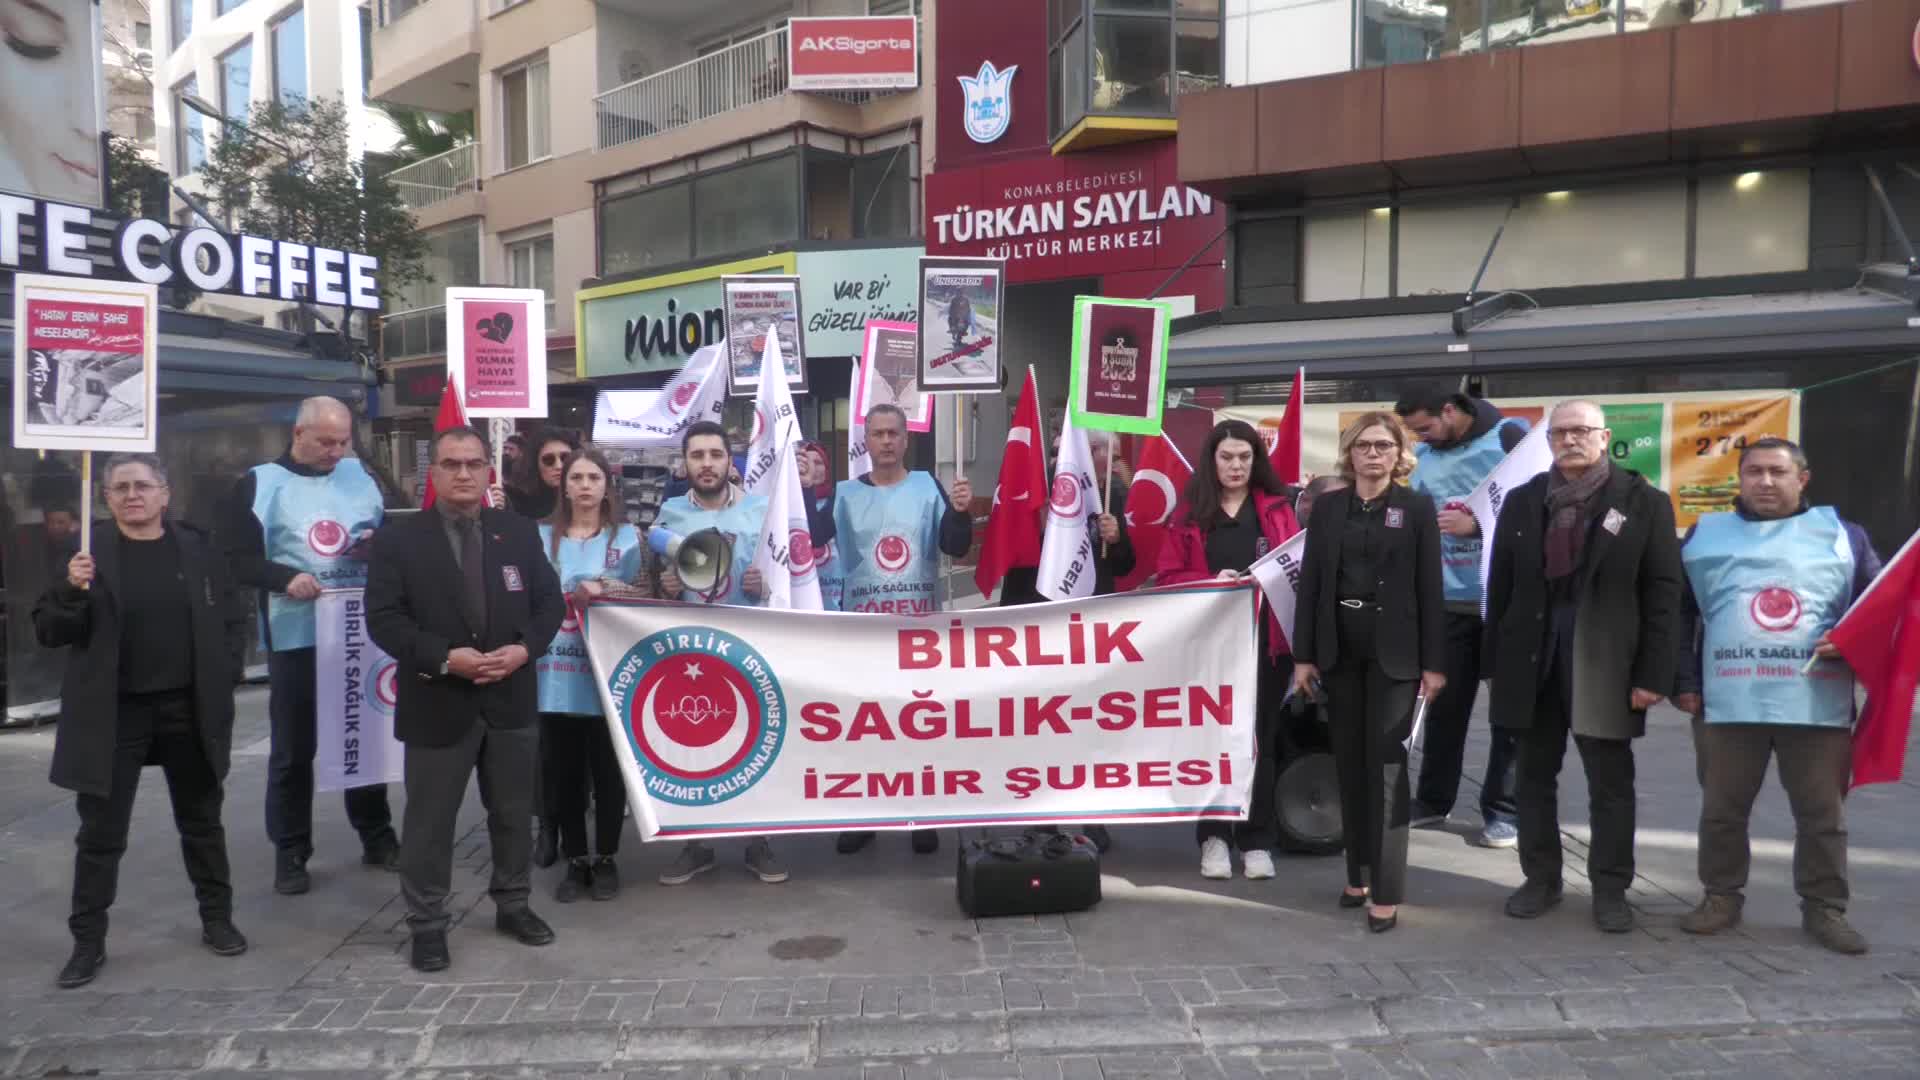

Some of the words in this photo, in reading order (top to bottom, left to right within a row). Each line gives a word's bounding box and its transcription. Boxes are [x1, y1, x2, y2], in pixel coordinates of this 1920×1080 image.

[799, 36, 912, 54] AKSigorta
[1004, 183, 1052, 200] KONAK
[1056, 171, 1142, 193] BELEDİYESİ
[933, 200, 1064, 244] TÜRKAN
[1073, 185, 1212, 229] SAYLAN
[121, 218, 380, 310] COFFEE
[986, 238, 1062, 260] KÜLTÜR
[1068, 226, 1161, 253] MERKEZİ
[834, 280, 863, 301] VAR
[478, 367, 514, 377] HAYAT
[344, 599, 365, 662] BİRLİK
[652, 632, 732, 656] BİRLİK
[897, 612, 1145, 670] BİRLİK
[344, 667, 364, 734] SAĞLIK
[742, 655, 781, 728] SENDİKASI
[799, 684, 1234, 742] SAĞLIK-SEN
[344, 739, 361, 776] SEN
[708, 731, 778, 801] ÇALIŞANLARI
[803, 764, 984, 800] İZMİR
[1005, 752, 1233, 799] ŞUBESİ
[648, 774, 704, 800] HİZMET
